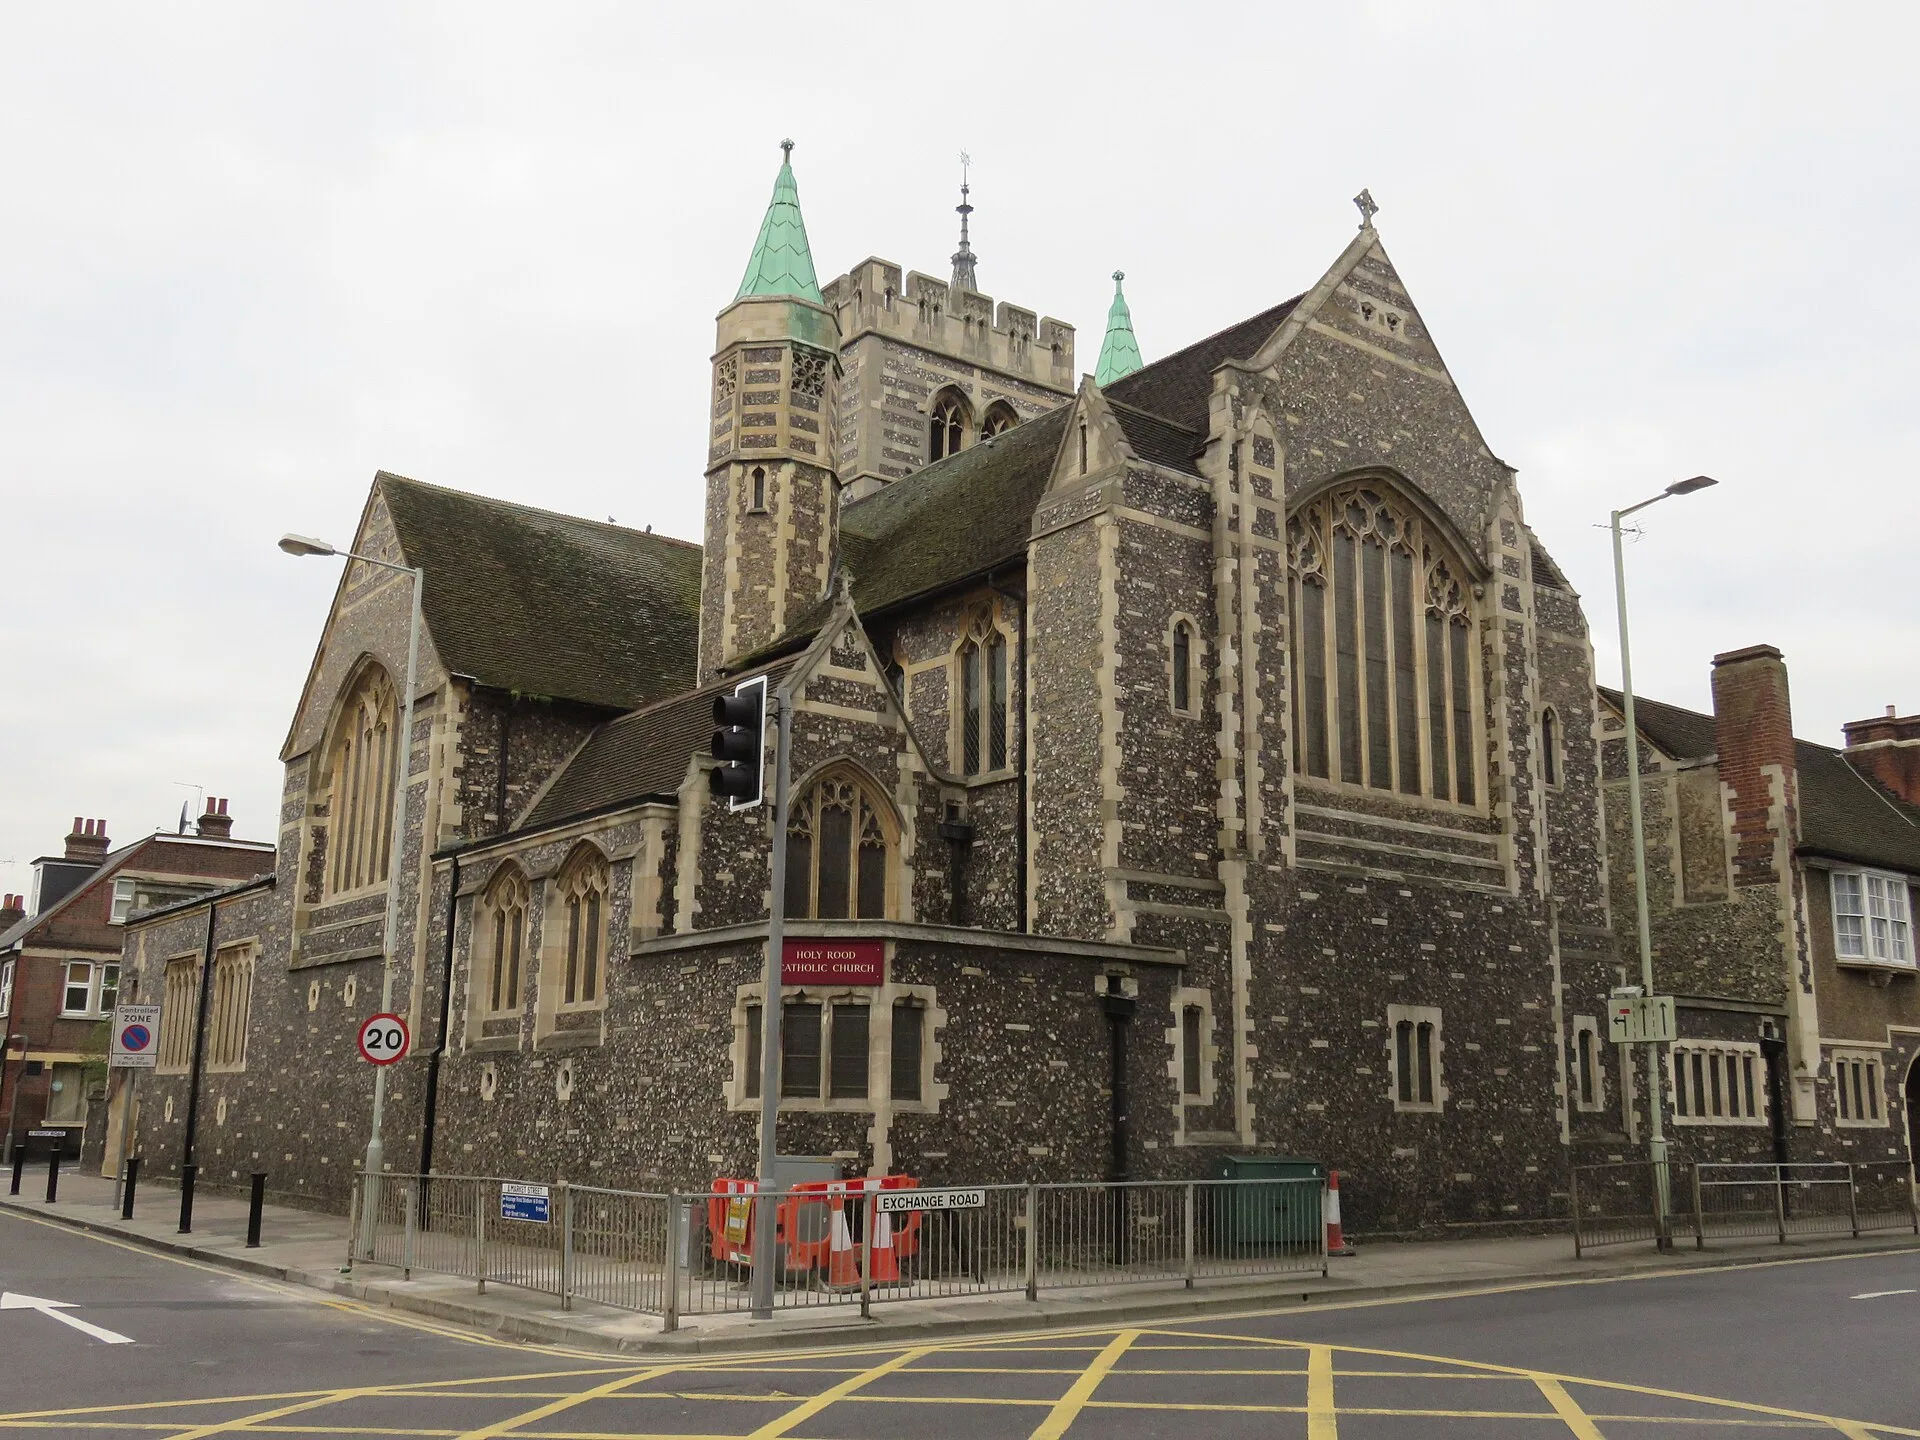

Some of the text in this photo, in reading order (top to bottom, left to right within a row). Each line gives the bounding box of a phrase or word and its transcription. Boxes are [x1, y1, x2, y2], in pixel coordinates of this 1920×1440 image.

[796, 951, 856, 960] HOLY ROOD
[832, 964, 874, 973] CHURCH
[119, 1006, 159, 1014] Controlled
[123, 1014, 152, 1023] ZONE
[366, 1028, 403, 1050] 20
[510, 1185, 527, 1194] MARKET
[527, 1186, 543, 1195] STREET
[883, 1194, 979, 1209] EXCHANGE ROAD
